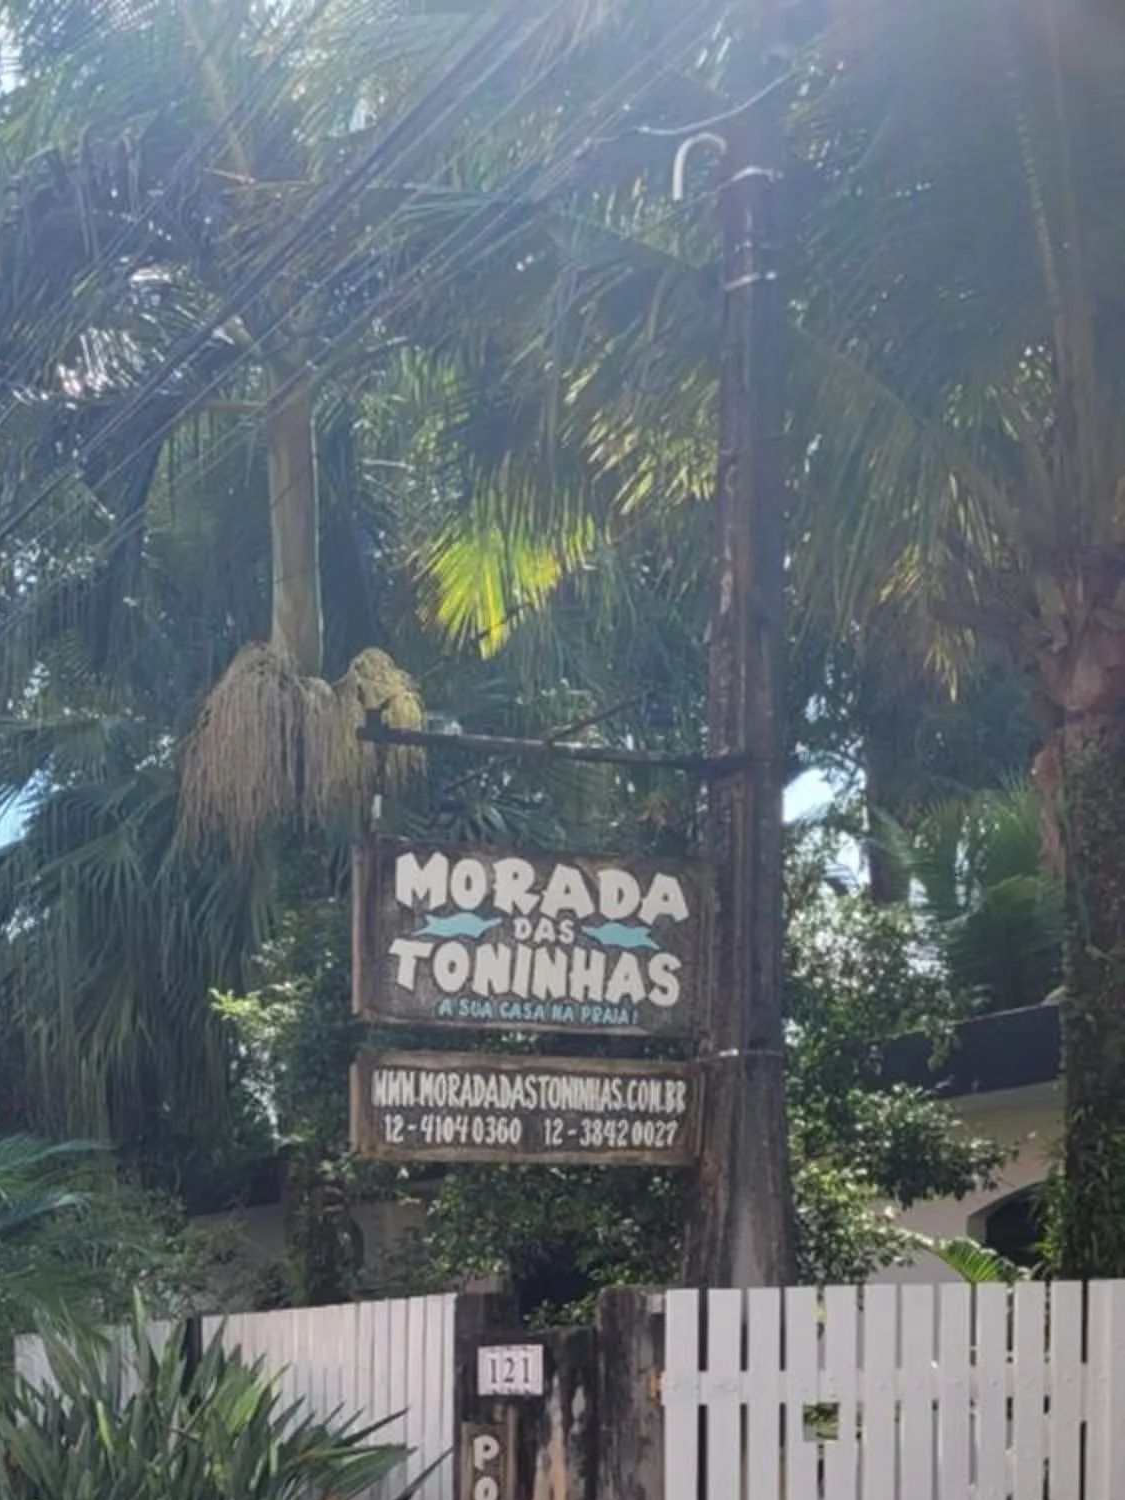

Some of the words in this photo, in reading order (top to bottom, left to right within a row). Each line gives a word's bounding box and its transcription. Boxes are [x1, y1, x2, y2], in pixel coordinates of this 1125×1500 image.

[395, 851, 689, 926] MORADA
[512, 916, 576, 945] DAS
[389, 938, 682, 1007] TONINHAS
[438, 1000, 452, 1015] A
[499, 1002, 545, 1021] CASA
[551, 1005, 574, 1021] NA
[372, 1069, 687, 1114] WWW.MORADADASTONINHAS.COM.BR
[488, 1356, 531, 1384] 121
